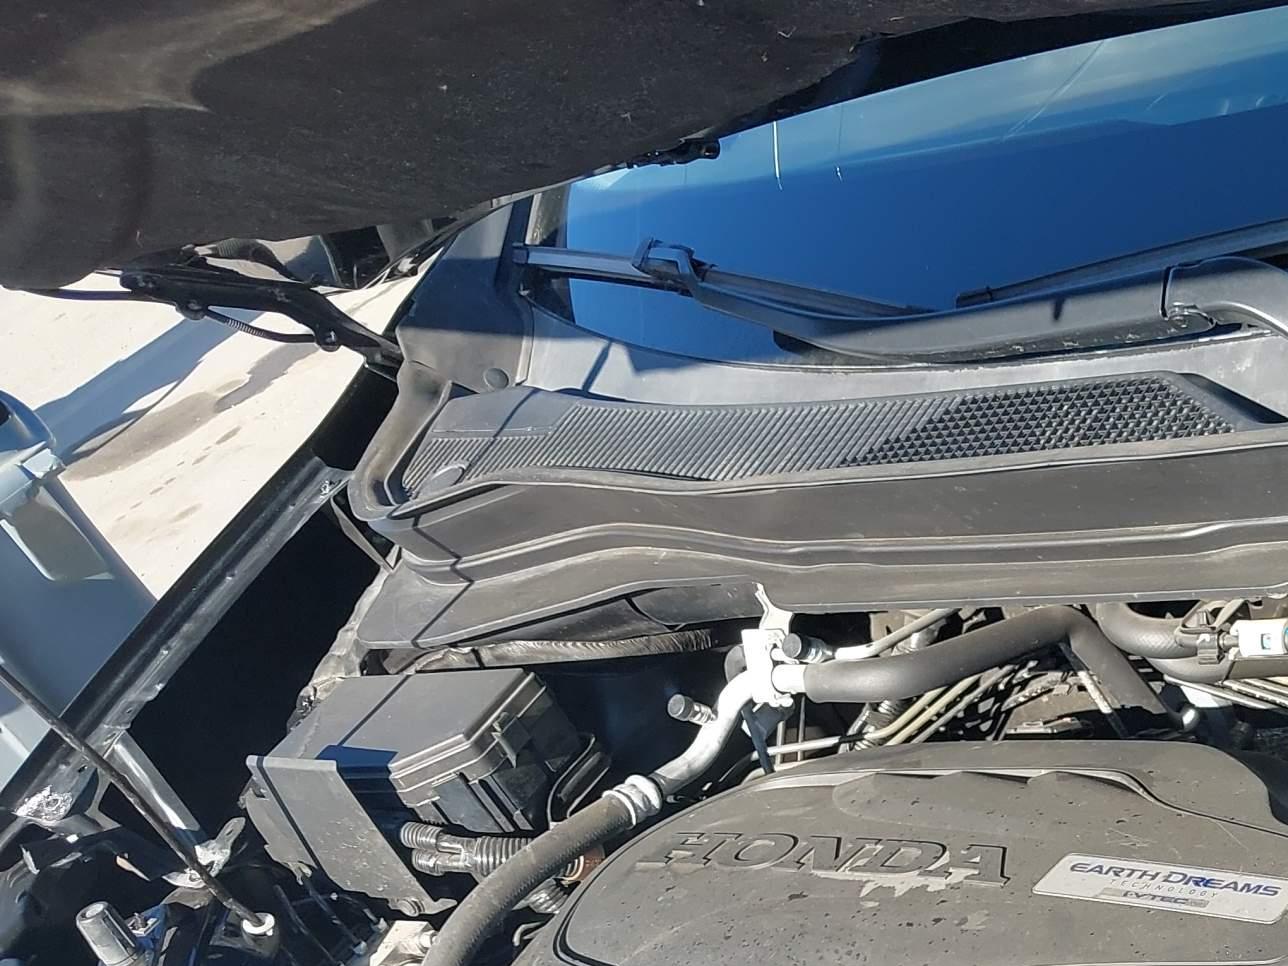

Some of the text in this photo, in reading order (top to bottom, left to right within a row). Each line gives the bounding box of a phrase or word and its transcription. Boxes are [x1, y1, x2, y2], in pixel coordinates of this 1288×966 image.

[663, 831, 1011, 887] HONDA
[1069, 862, 1283, 897] EARTH DREAMS
[1109, 879, 1219, 898] TECHNOLOGY
